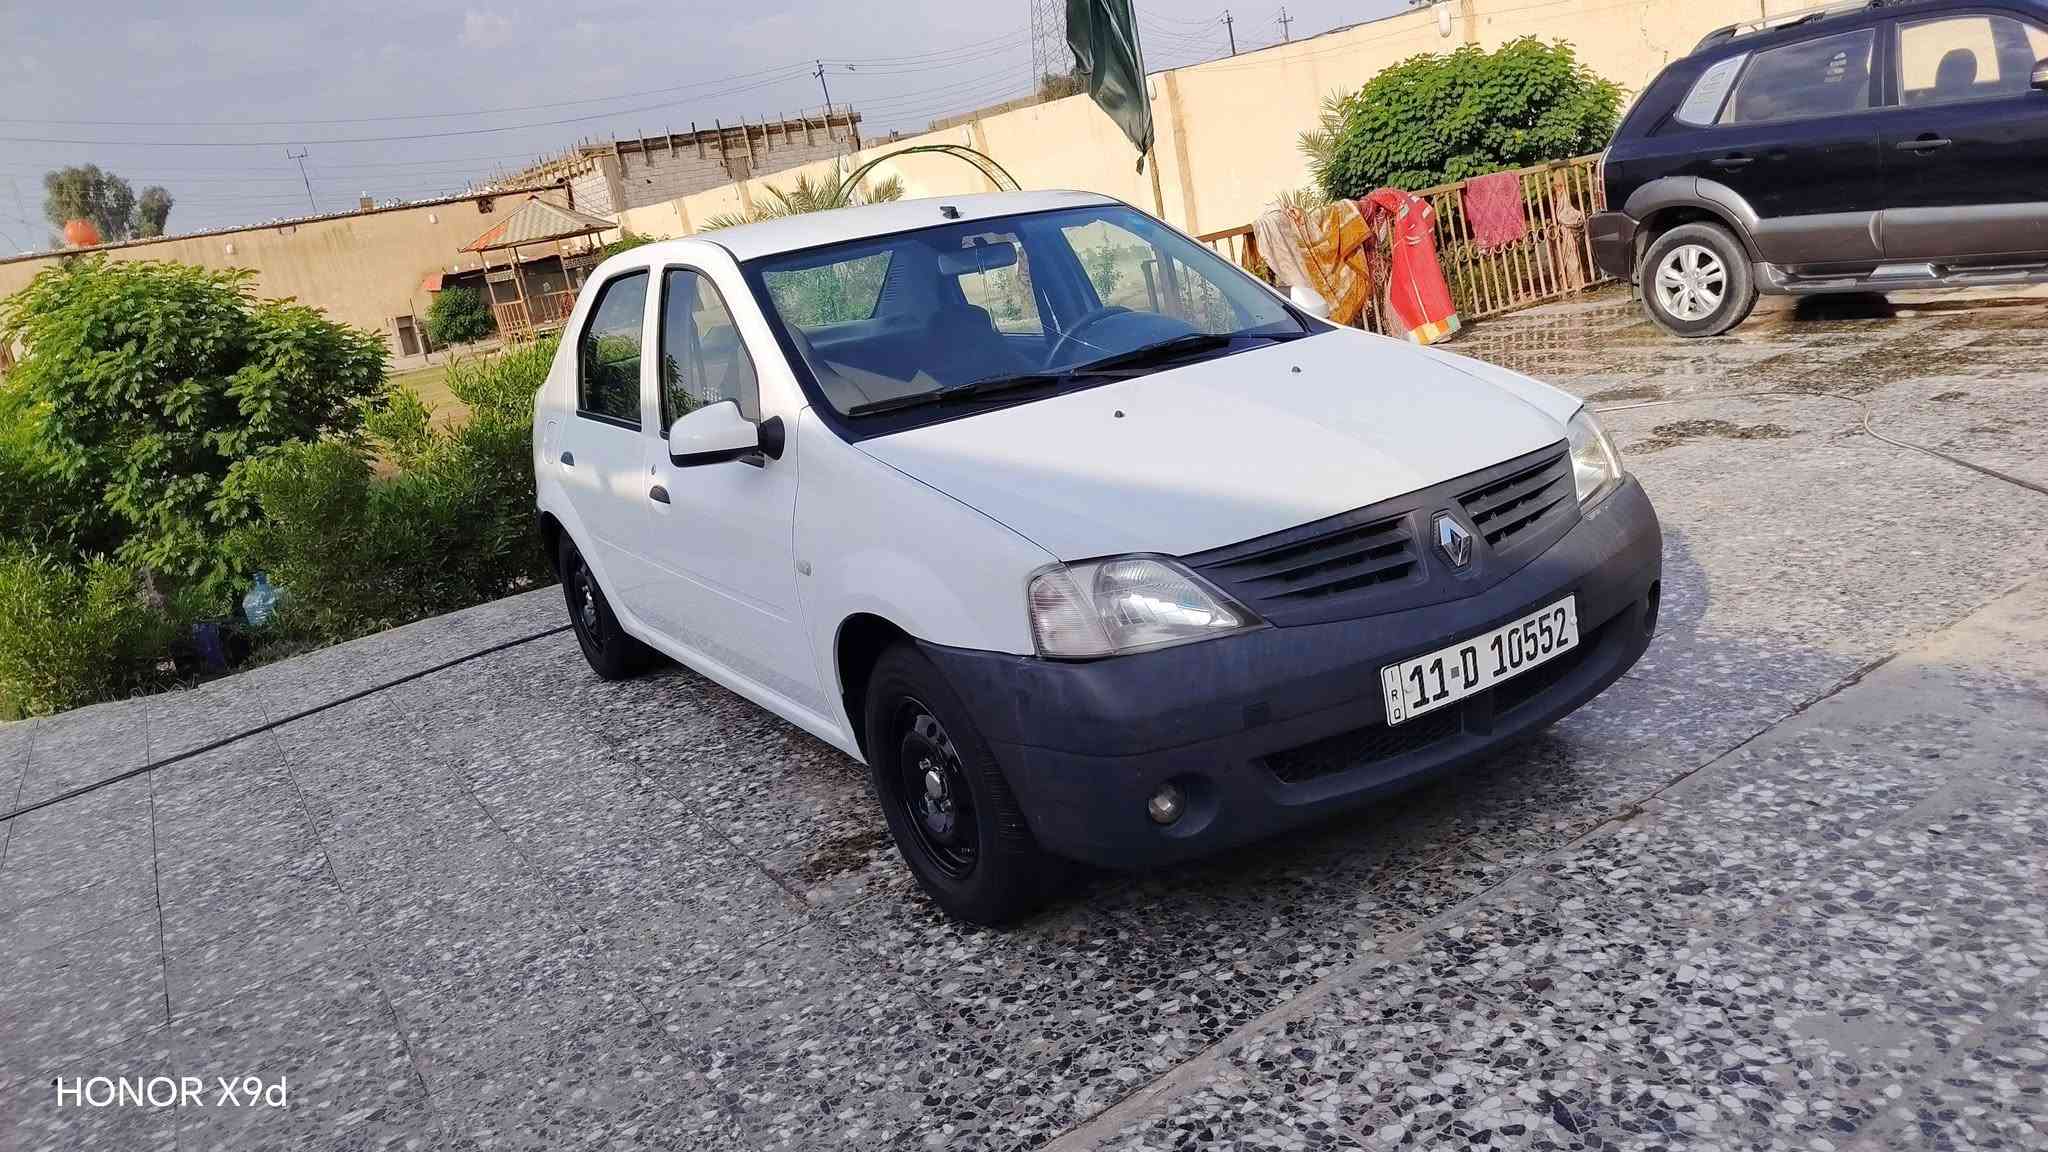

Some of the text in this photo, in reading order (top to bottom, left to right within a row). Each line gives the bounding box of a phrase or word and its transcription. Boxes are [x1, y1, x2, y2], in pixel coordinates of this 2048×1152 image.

[1409, 607, 1569, 709] 11 D 10552
